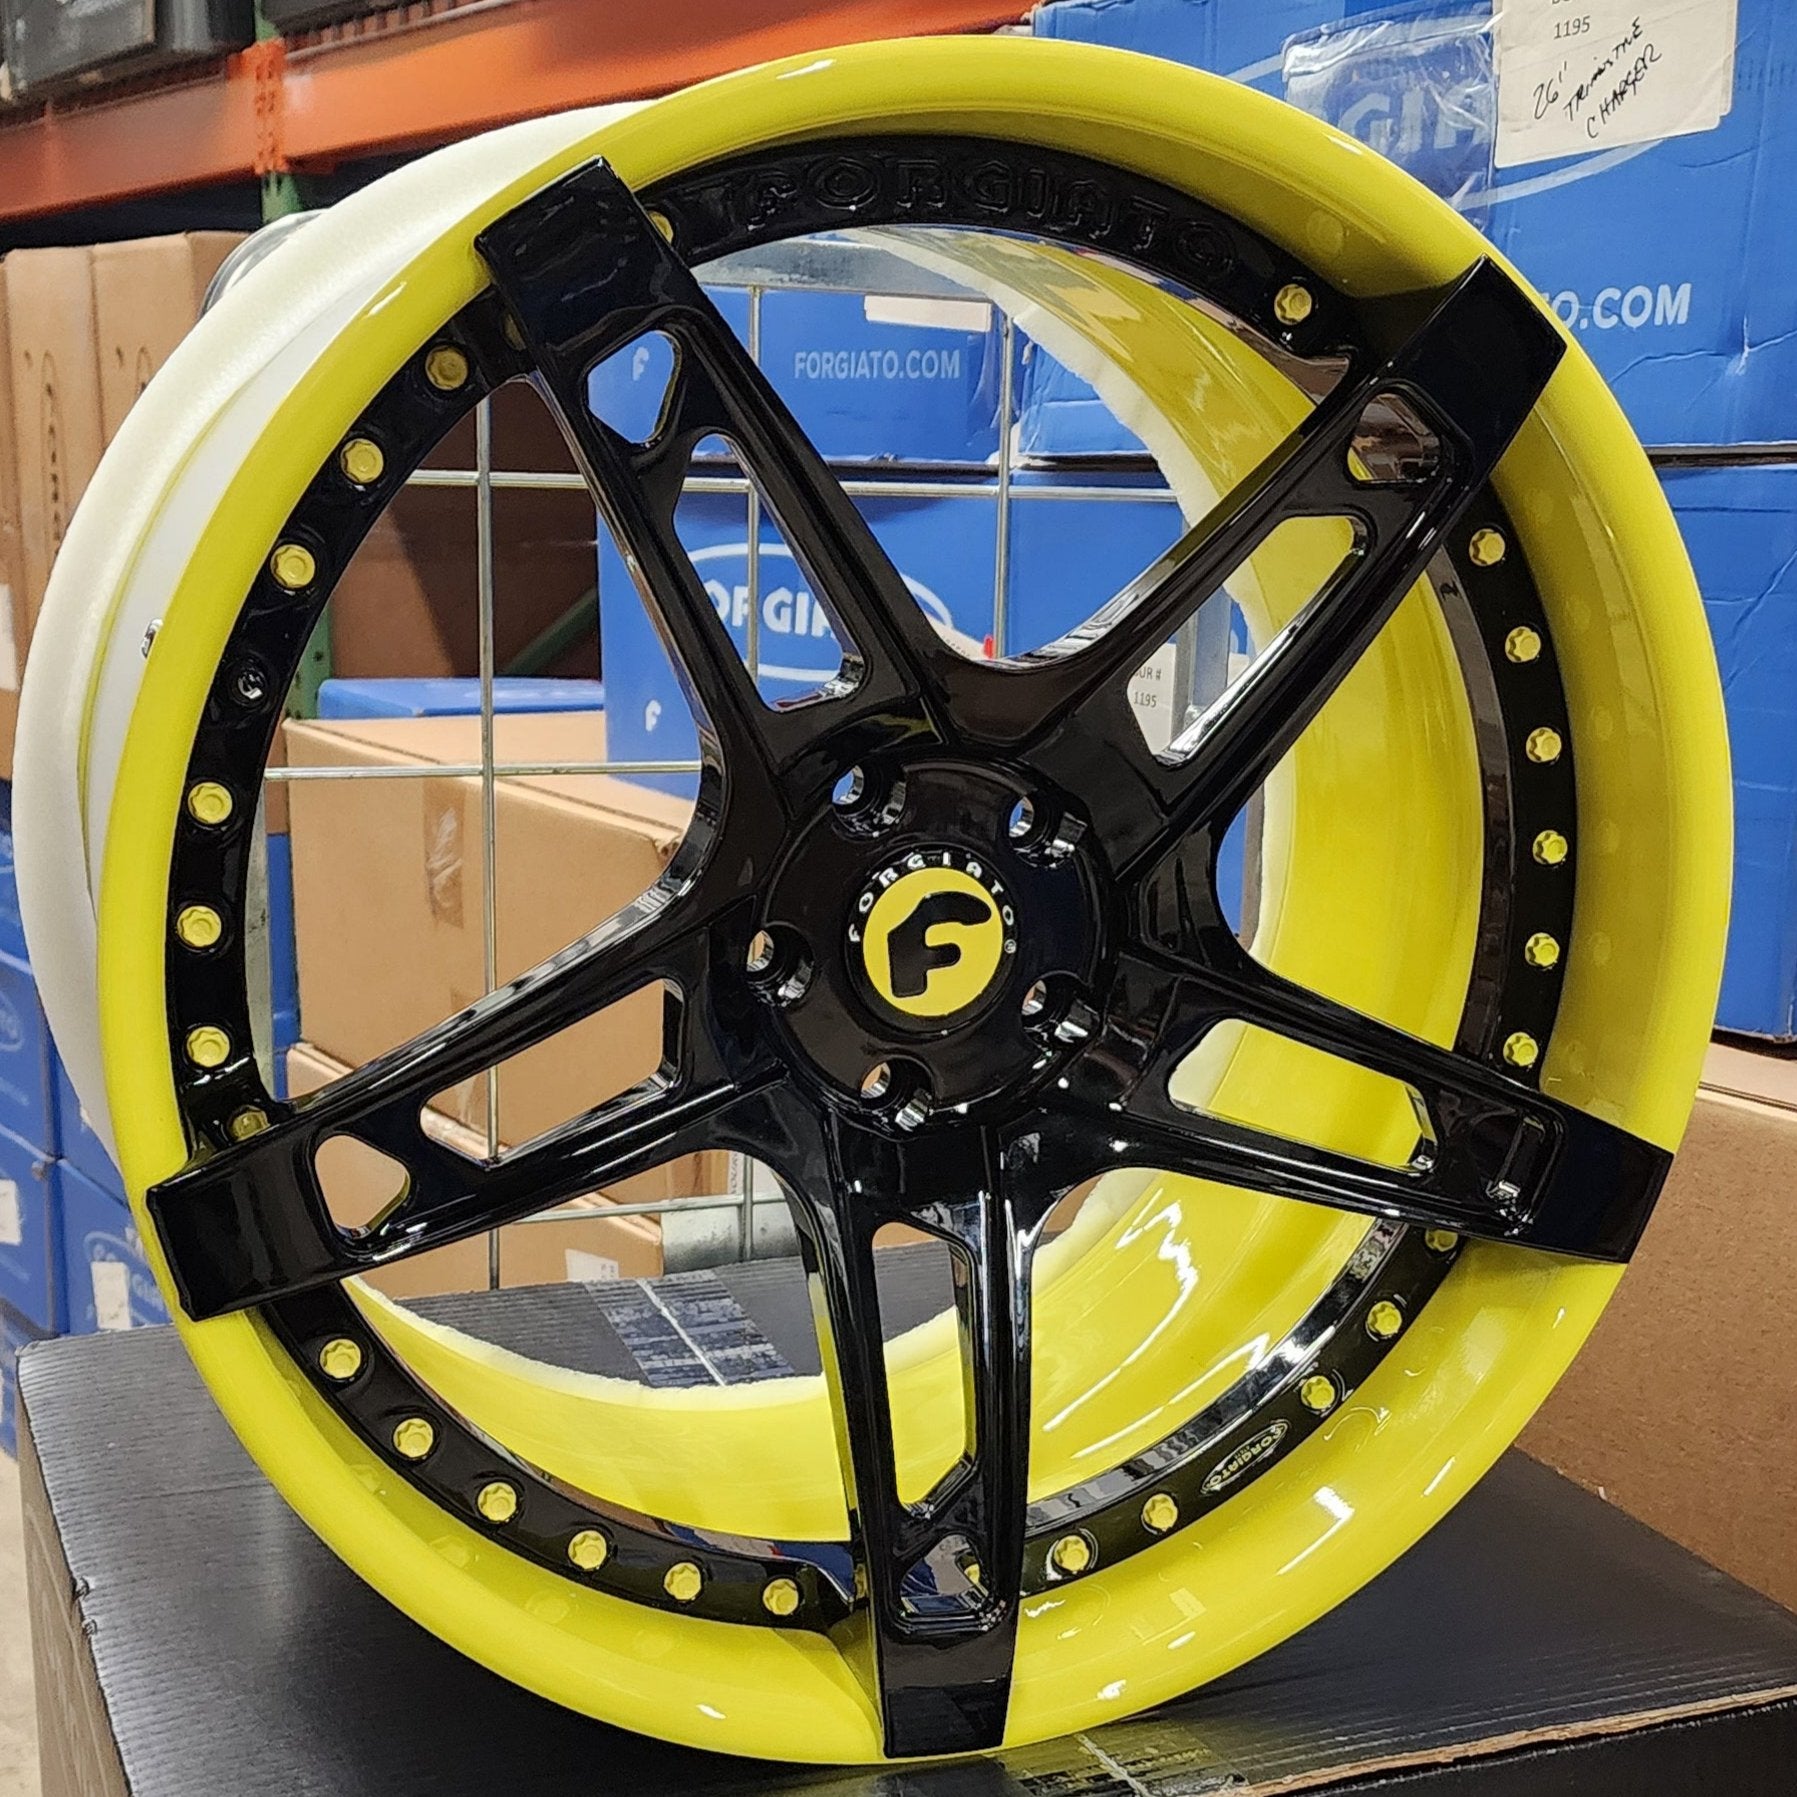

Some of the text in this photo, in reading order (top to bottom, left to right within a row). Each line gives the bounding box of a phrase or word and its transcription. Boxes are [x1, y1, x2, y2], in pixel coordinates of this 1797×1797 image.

[1553, 15, 1590, 39] 1195
[794, 349, 961, 380] FORGIATO.COM
[1134, 691, 1157, 708] 1195
[848, 851, 1015, 943] FORGIATO
[1208, 1426, 1285, 1488] FORGIATO
